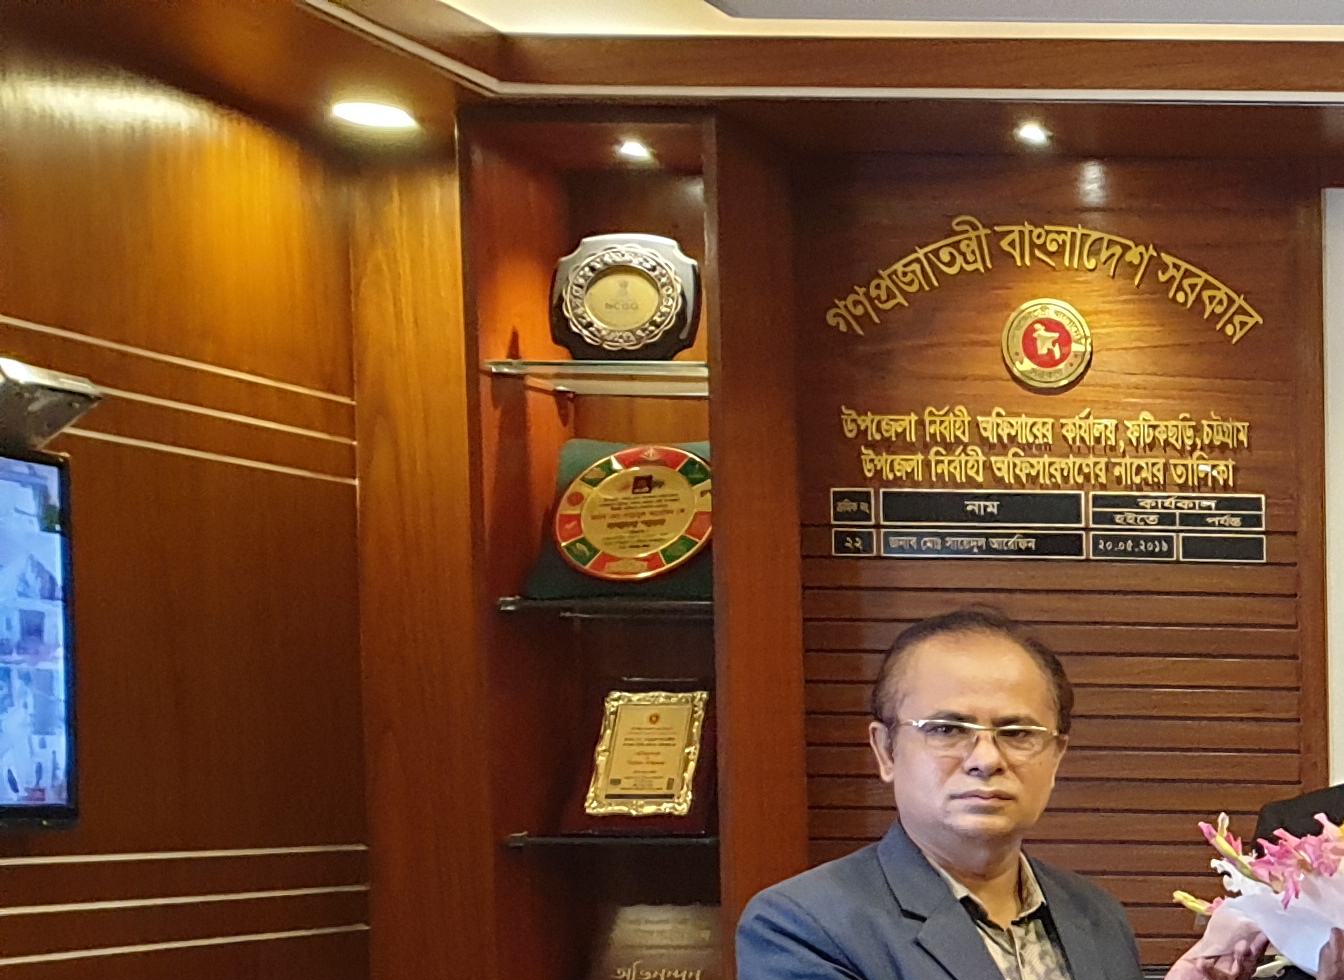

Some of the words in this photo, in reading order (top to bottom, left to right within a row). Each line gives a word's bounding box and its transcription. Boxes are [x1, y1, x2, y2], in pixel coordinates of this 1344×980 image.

[826, 215, 992, 336] গণপ্রজাতন্ত্রী
[994, 221, 1158, 287] বাংলাদেশ
[1157, 253, 1264, 344] সরকার
[841, 405, 918, 442] উপজেলা
[924, 406, 971, 442] নির্বাহী
[977, 407, 1054, 444] অফিসারের
[861, 446, 924, 481] উপজেলা
[928, 446, 986, 482] নির্বাহী
[990, 447, 1109, 485] অফিসারগণের
[1110, 455, 1166, 486] নামের
[1169, 450, 1236, 487] তালিকা
[964, 500, 1001, 516] নাম
[1136, 496, 1217, 511] কার্যকাল
[1113, 512, 1160, 526] হইতে
[1205, 514, 1243, 528] পর্যন্ত
[844, 536, 863, 551] ২২
[888, 536, 917, 550] জনাব
